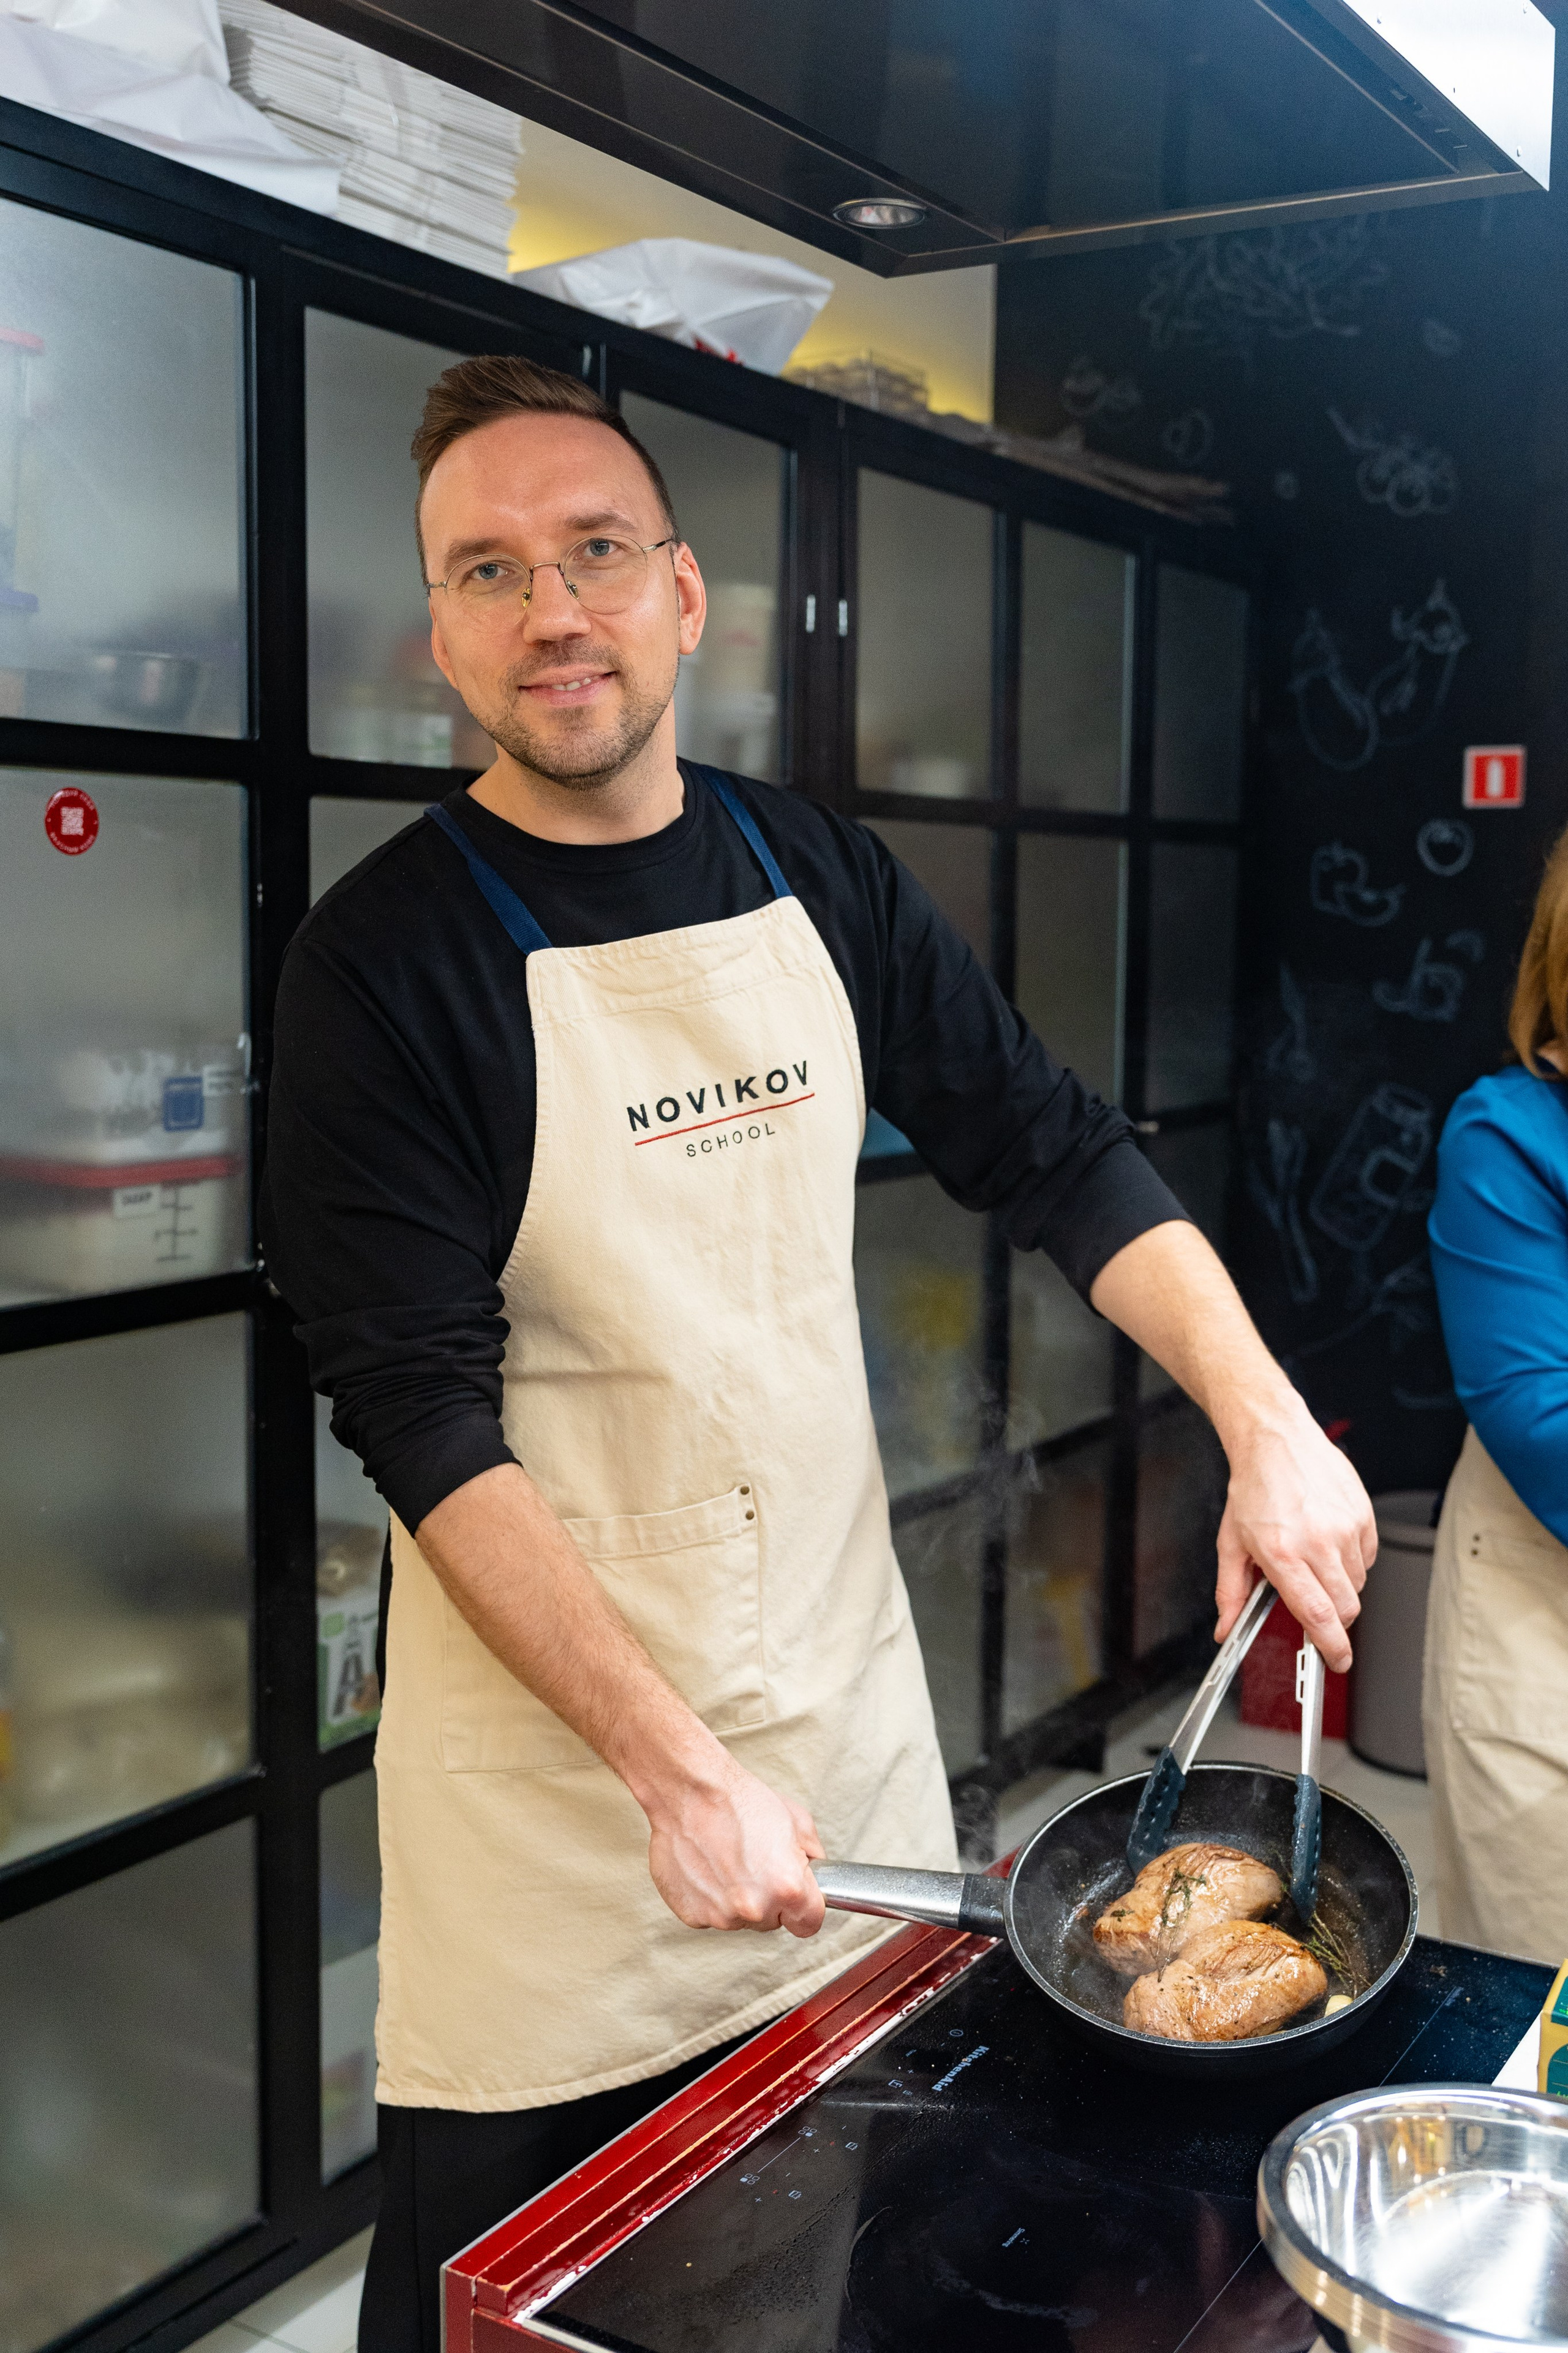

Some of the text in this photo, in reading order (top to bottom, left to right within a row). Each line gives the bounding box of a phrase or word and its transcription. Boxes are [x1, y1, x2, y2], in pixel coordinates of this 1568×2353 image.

[626, 1060, 808, 1131] NOVIKOV
[685, 1123, 775, 1157] SCHOOL
[932, 2045, 990, 2091] KitchenAid
